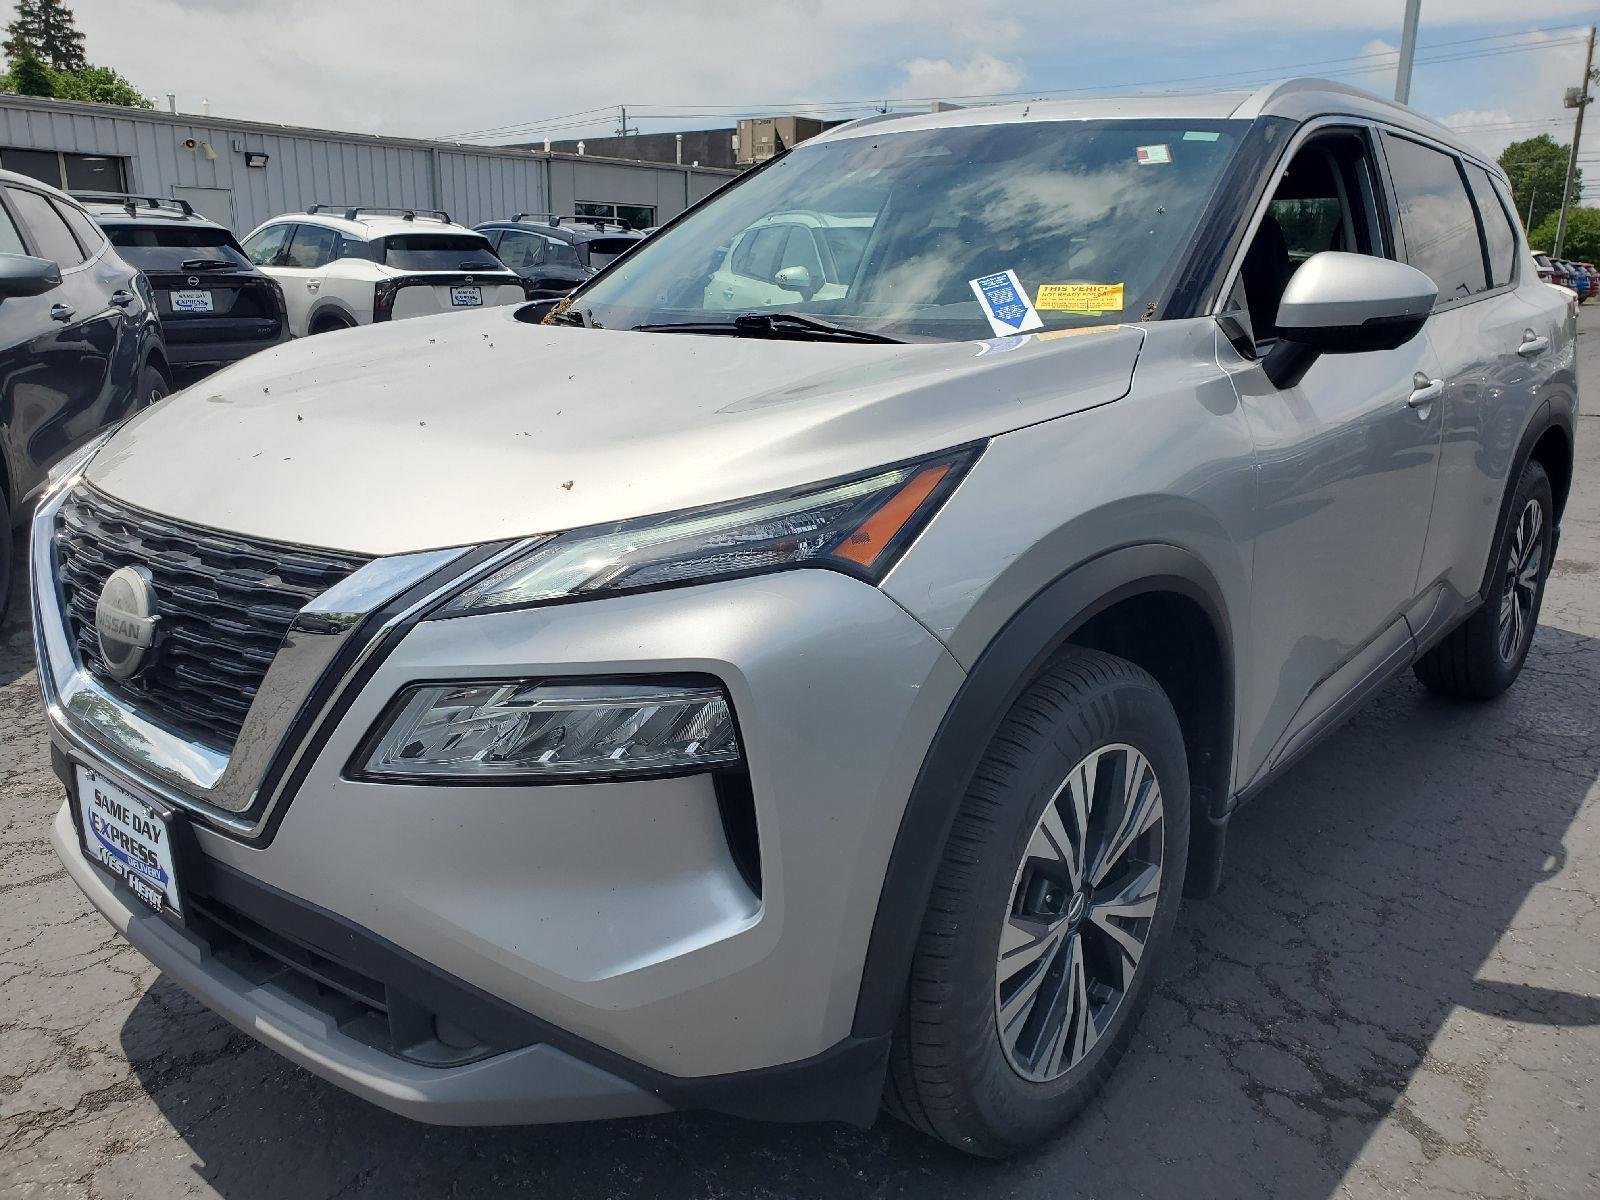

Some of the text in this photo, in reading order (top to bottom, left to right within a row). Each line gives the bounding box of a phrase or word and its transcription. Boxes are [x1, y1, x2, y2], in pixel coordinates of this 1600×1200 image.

[97, 609, 140, 640] NISSAN
[94, 788, 162, 845] SAME DAY
[91, 811, 159, 869] EXPRESS
[127, 855, 162, 881] DELIVERY
[128, 873, 163, 909] HERR
